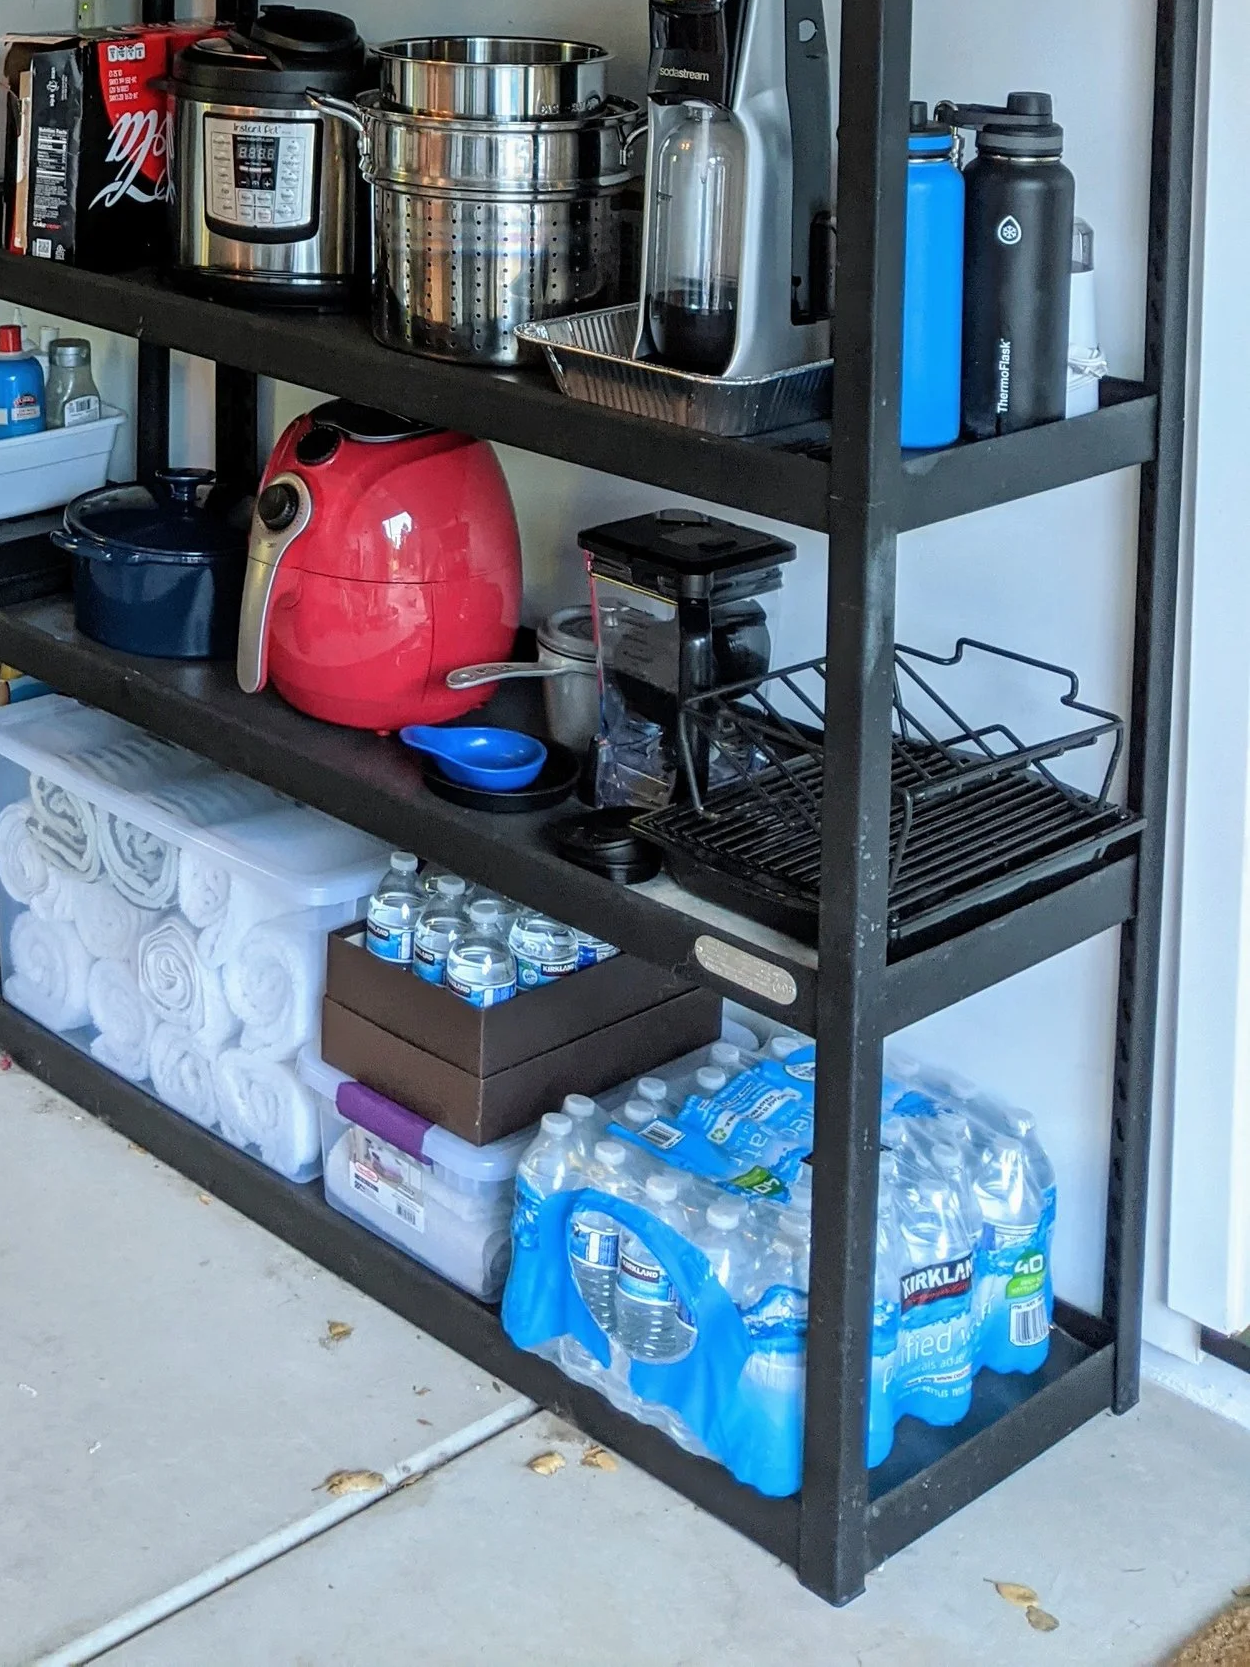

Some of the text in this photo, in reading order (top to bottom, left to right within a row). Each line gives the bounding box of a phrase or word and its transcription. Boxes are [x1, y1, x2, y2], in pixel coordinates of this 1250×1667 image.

[659, 67, 709, 82] sodastream
[233, 122, 279, 135] Instant Pot
[32, 218, 48, 229] Coke
[997, 340, 1011, 413] ThermoFlask
[542, 963, 576, 974] KIRKLAND
[622, 1259, 659, 1279] KIRKLAND
[1014, 1254, 1044, 1275] 40
